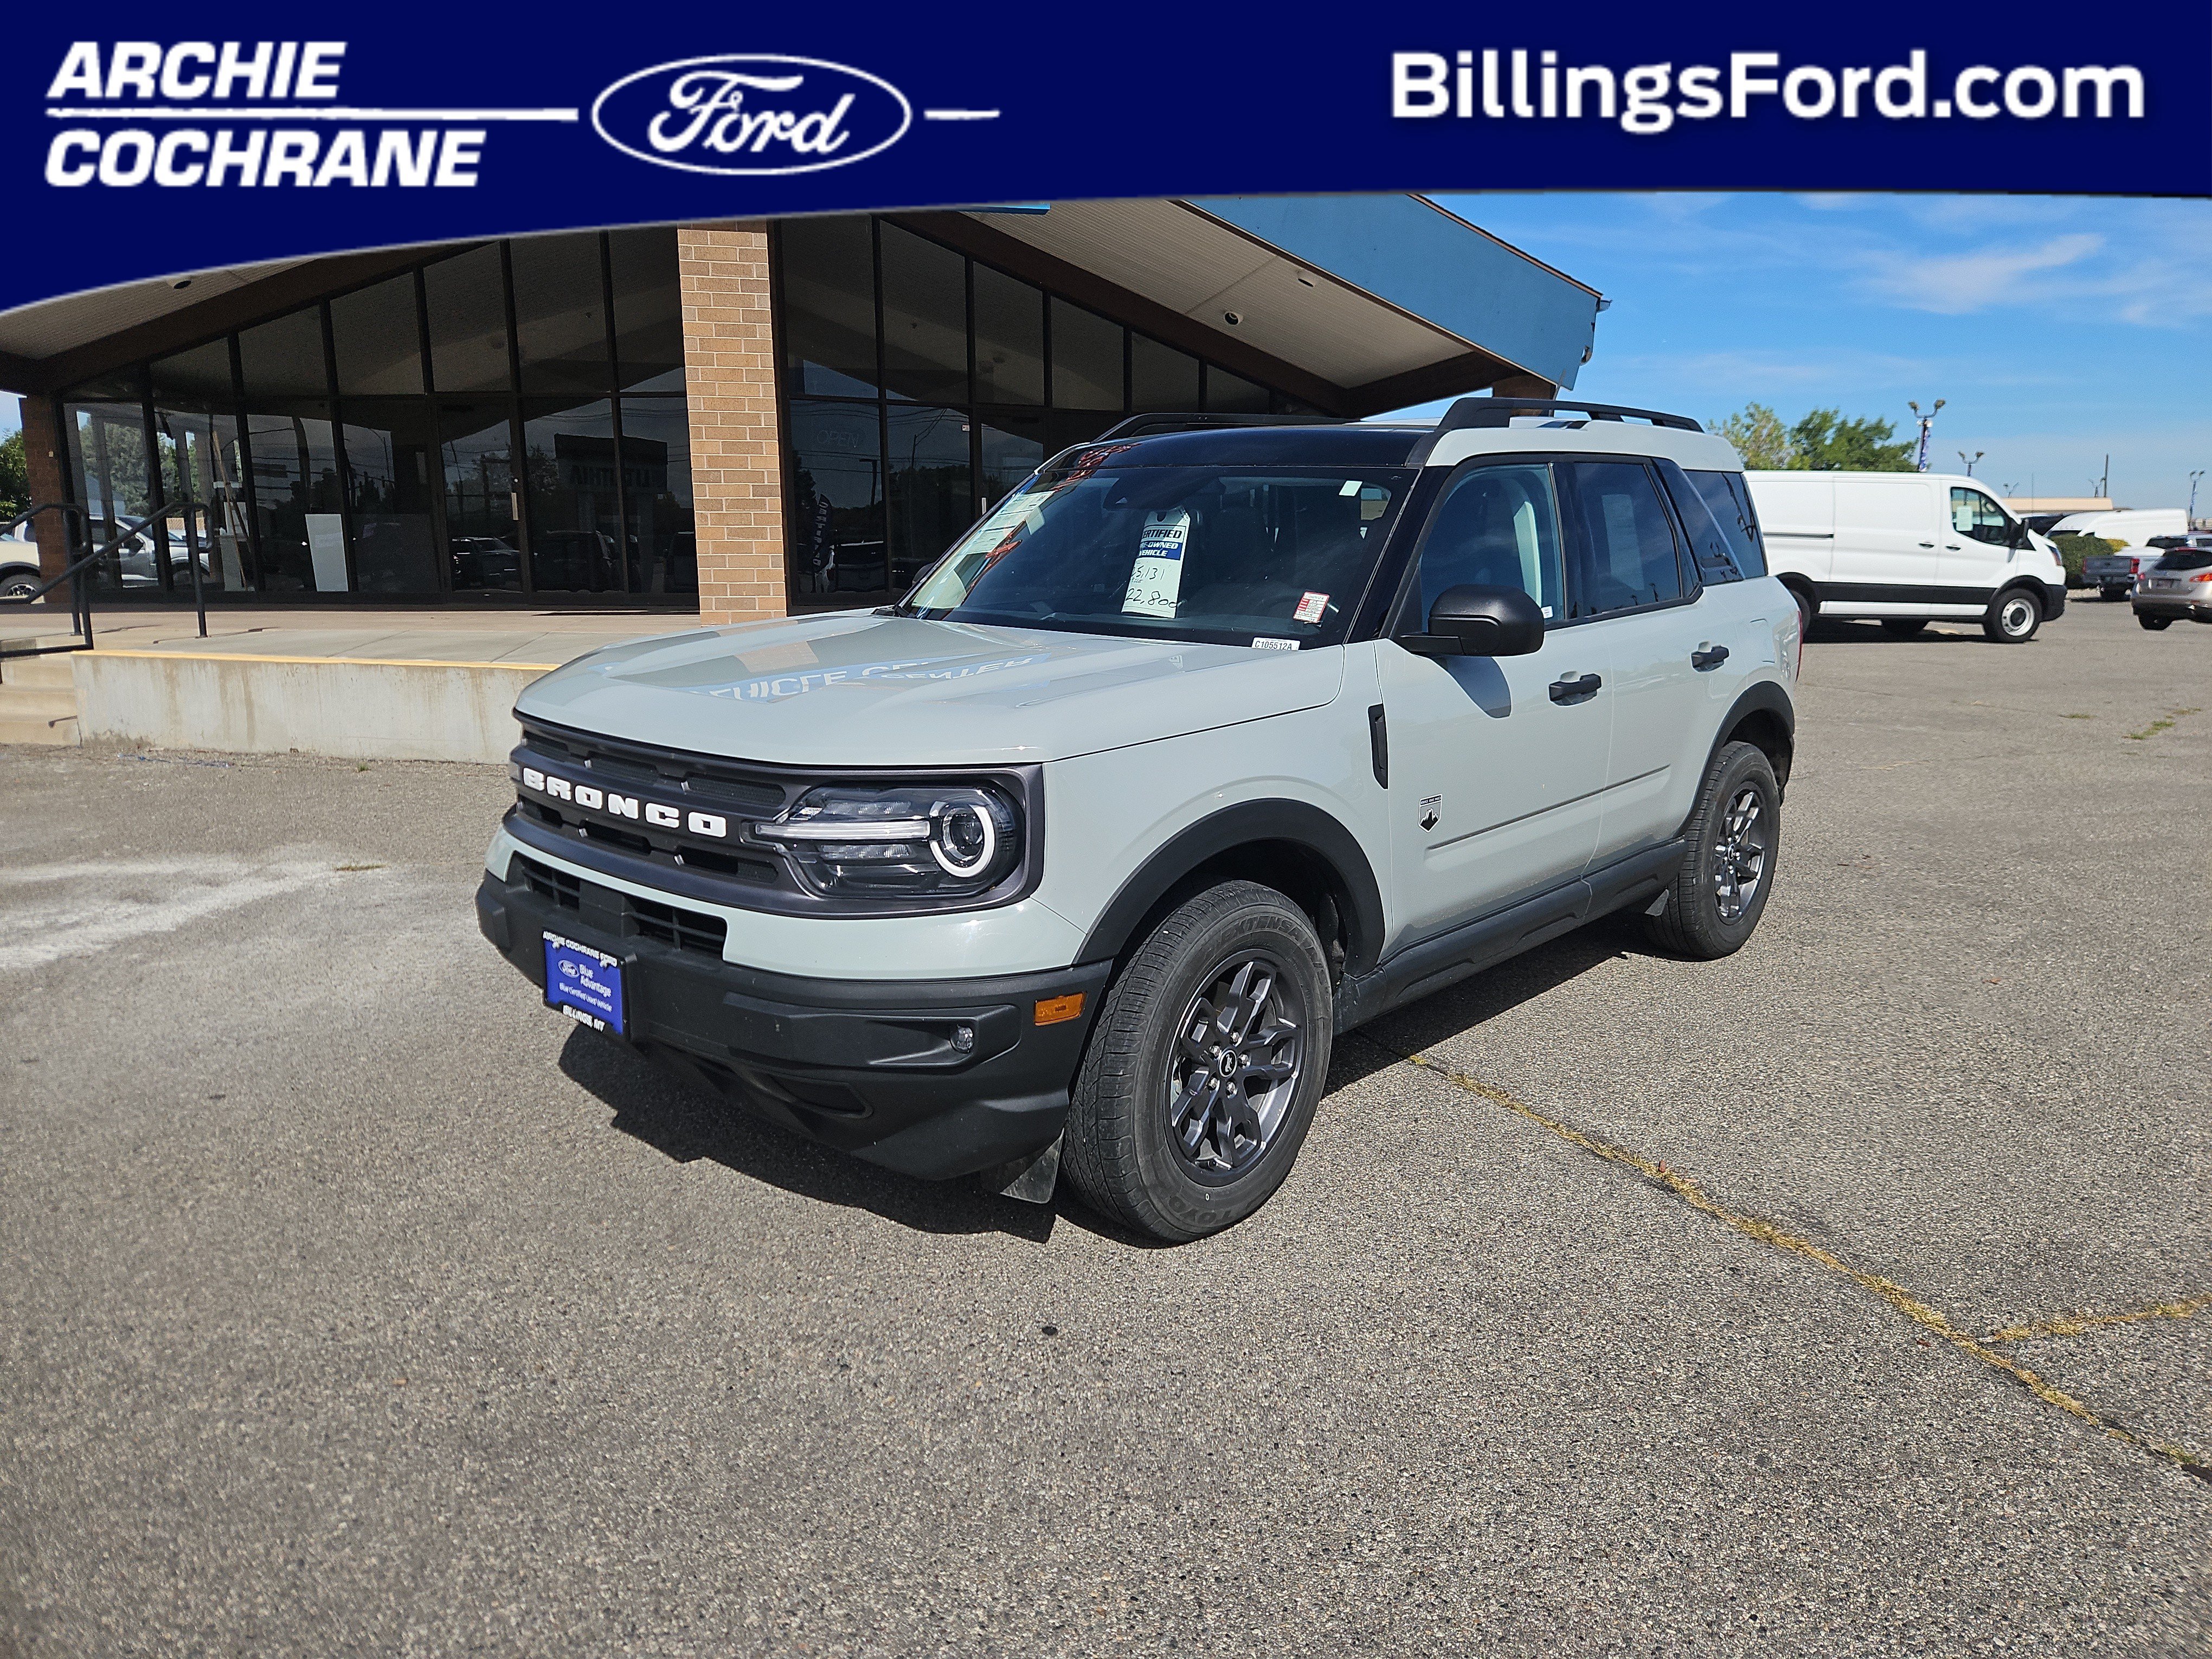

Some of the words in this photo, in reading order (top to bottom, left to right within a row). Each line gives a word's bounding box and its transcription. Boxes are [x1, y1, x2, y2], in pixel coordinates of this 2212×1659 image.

[1142, 529, 1182, 539] ERTIFIED
[1255, 640, 1293, 651] C105512A
[523, 767, 727, 838] BRONCO
[565, 939, 600, 960] COCHRANE
[579, 963, 594, 979] Blue
[580, 975, 612, 998] Advantage
